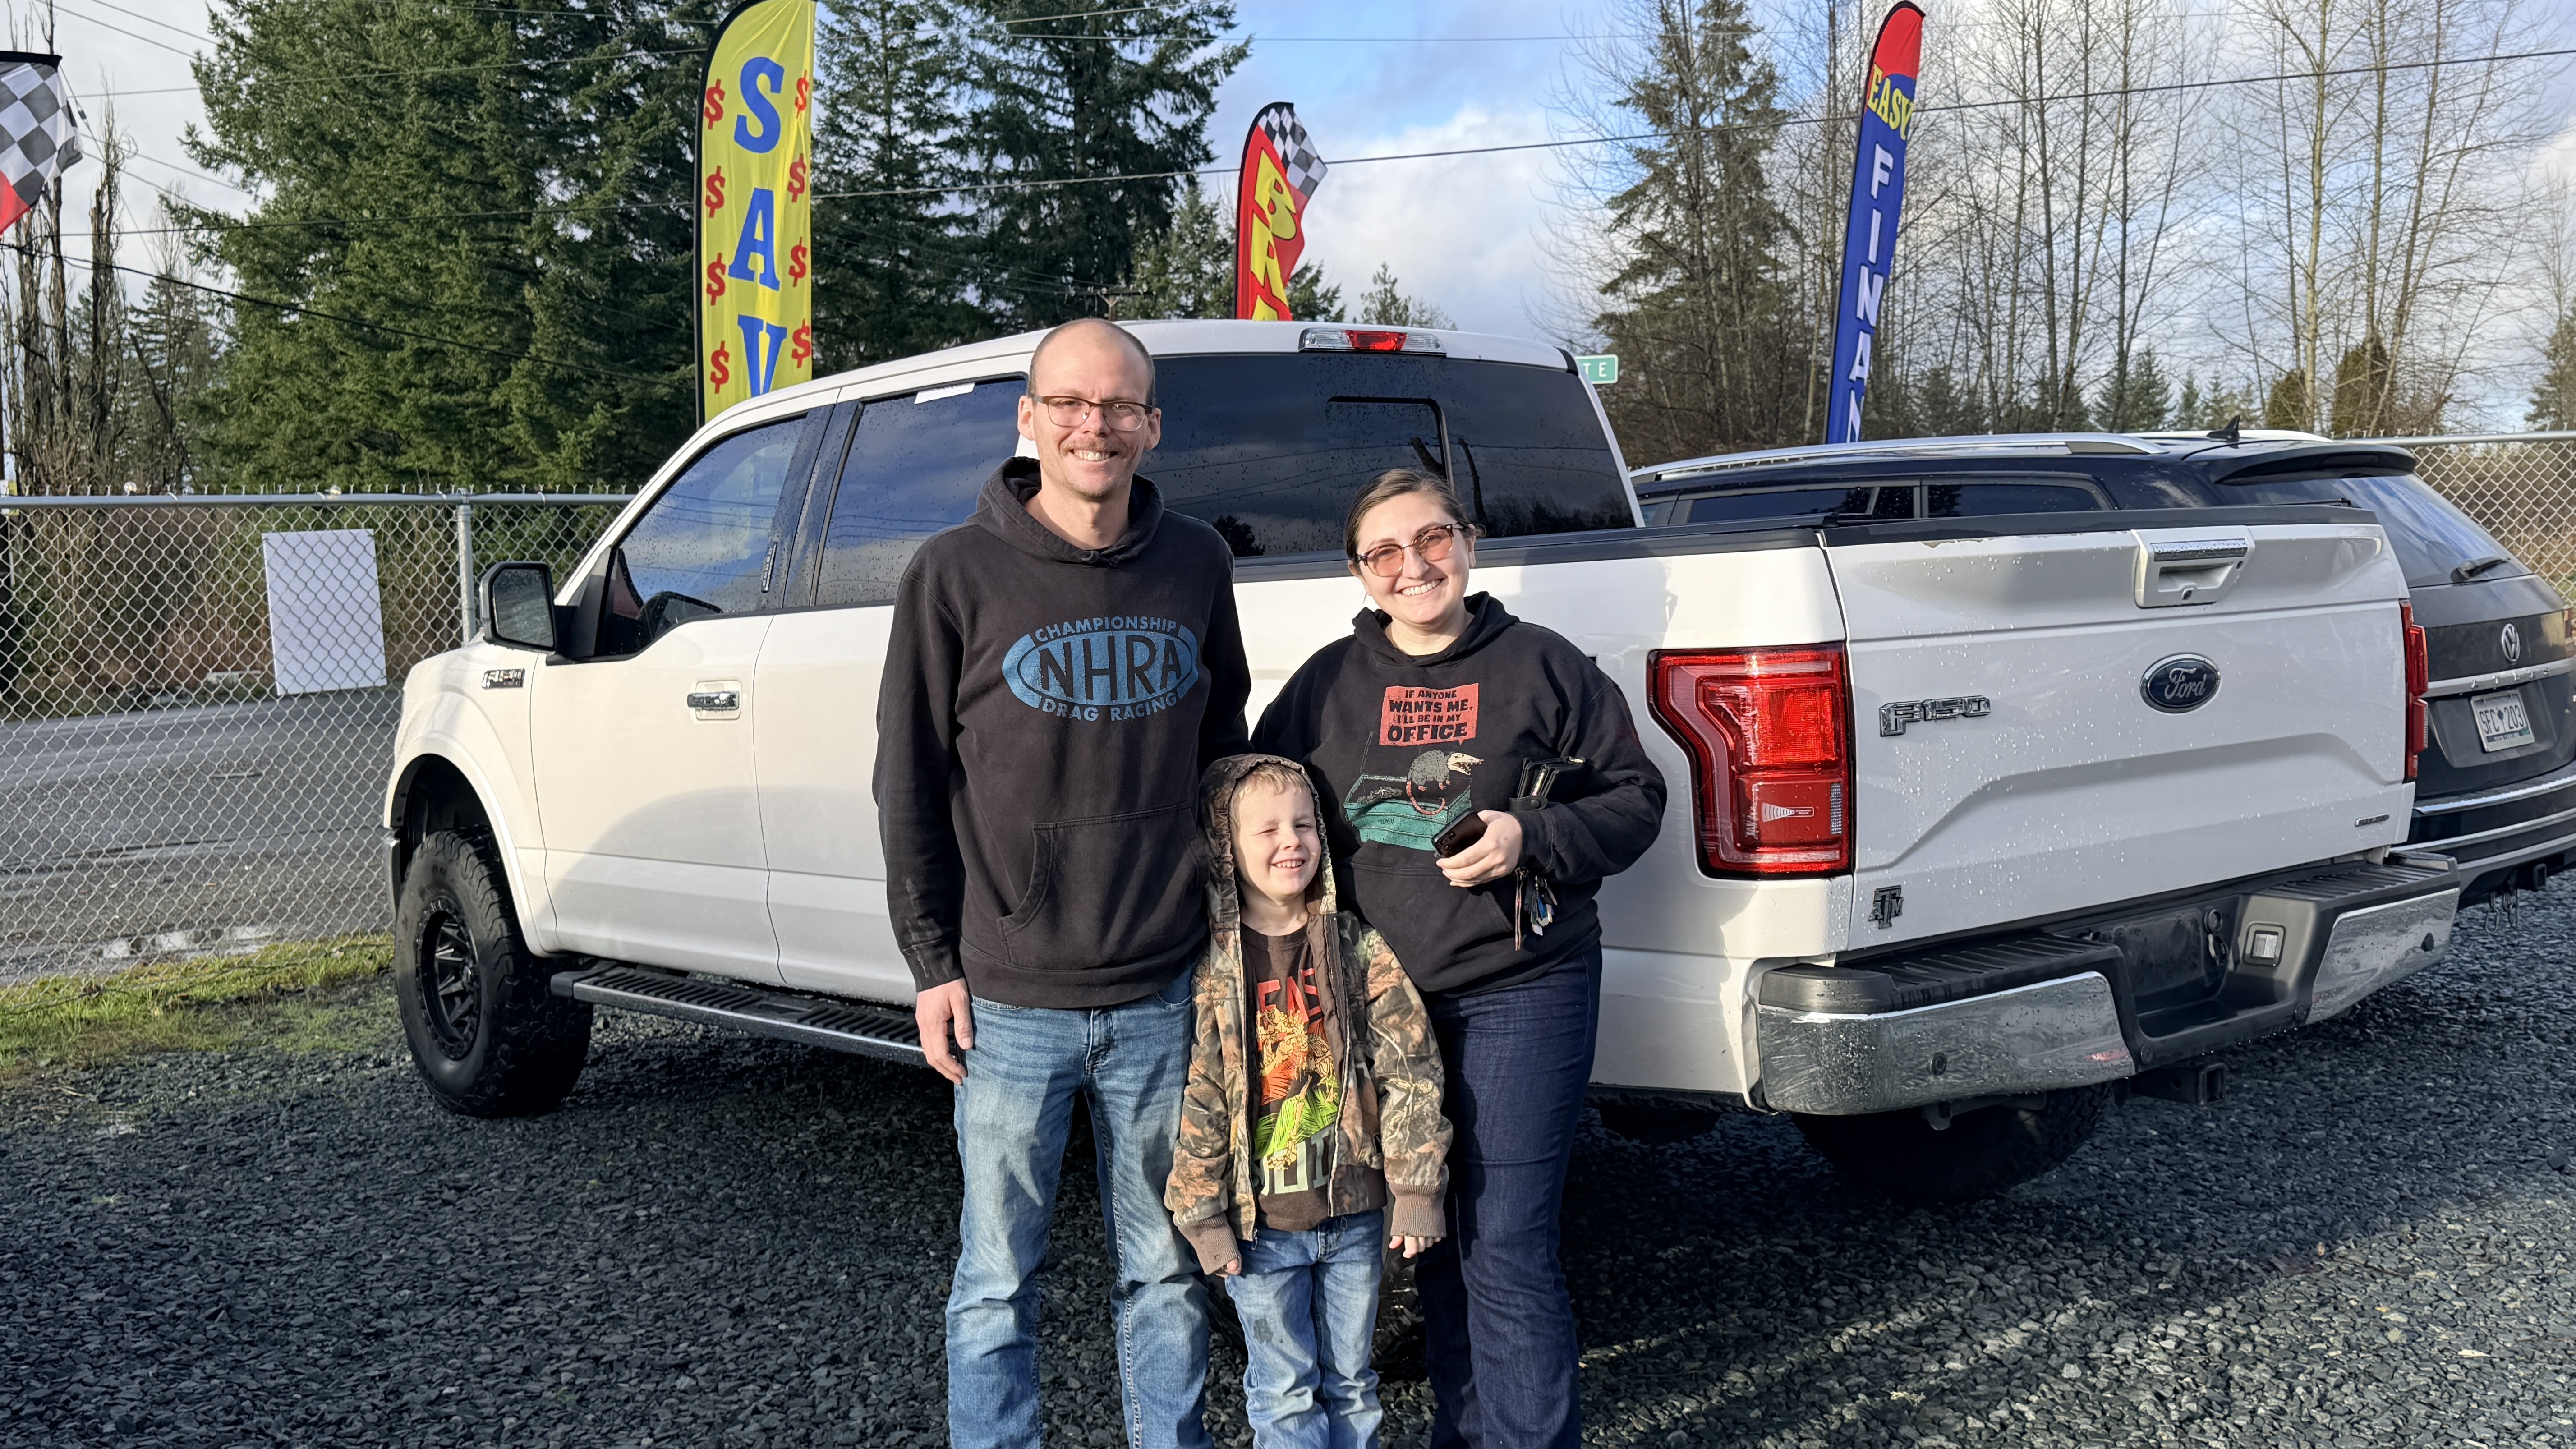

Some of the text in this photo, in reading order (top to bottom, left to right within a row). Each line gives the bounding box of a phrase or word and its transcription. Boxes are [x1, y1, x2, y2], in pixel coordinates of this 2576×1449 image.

[1867, 63, 1914, 141] EASY
[1599, 362, 1607, 377] E
[1035, 616, 1177, 642] CHAMPIONSHIP
[1039, 635, 1182, 700] NHRA
[1405, 690, 1457, 699] IF ANYONE
[2164, 667, 2207, 700] Ford
[1042, 692, 1178, 721] DRAG RACING
[1389, 700, 1442, 713] WANTS
[1446, 713, 1462, 722] MY
[2479, 705, 2524, 734] SFC 203
[1388, 722, 1468, 742] OFFICE
